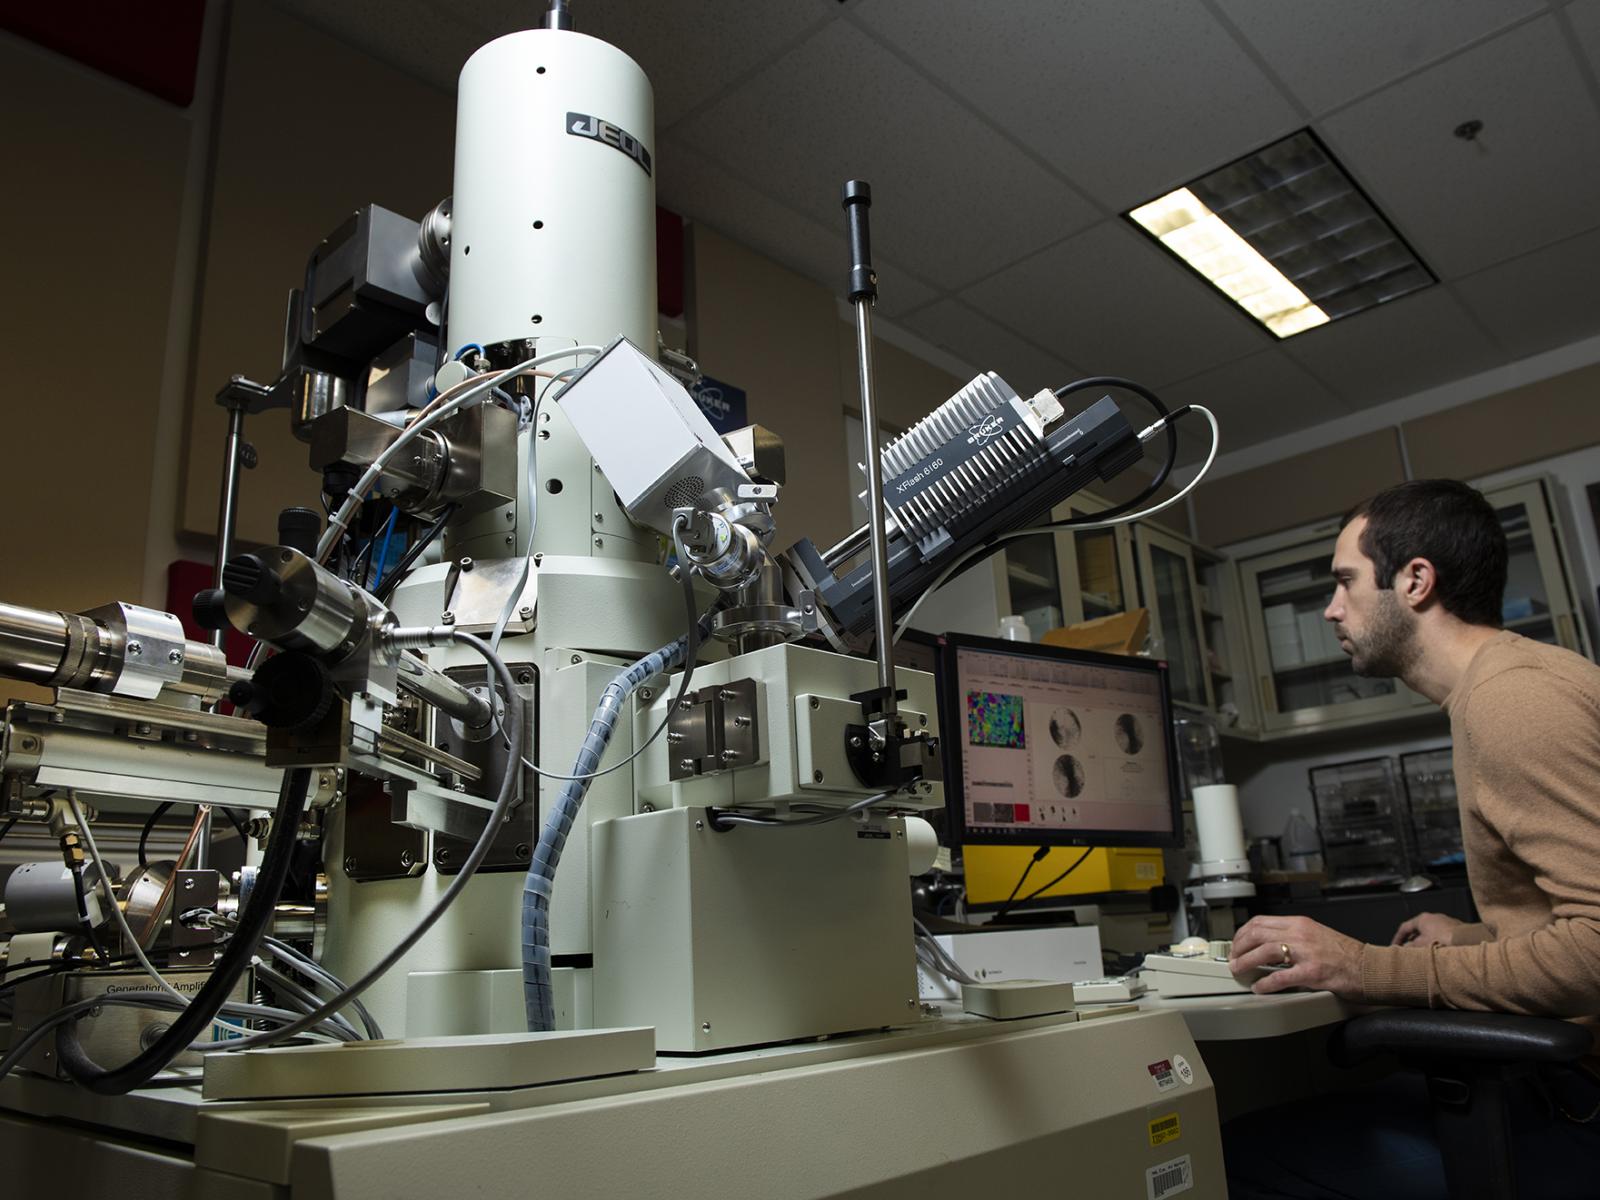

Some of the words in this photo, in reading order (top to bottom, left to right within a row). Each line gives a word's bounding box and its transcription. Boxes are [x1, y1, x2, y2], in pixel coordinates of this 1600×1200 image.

[571, 117, 651, 173] JEOL
[967, 417, 1004, 444] BRUKER
[896, 472, 925, 493] XFlash
